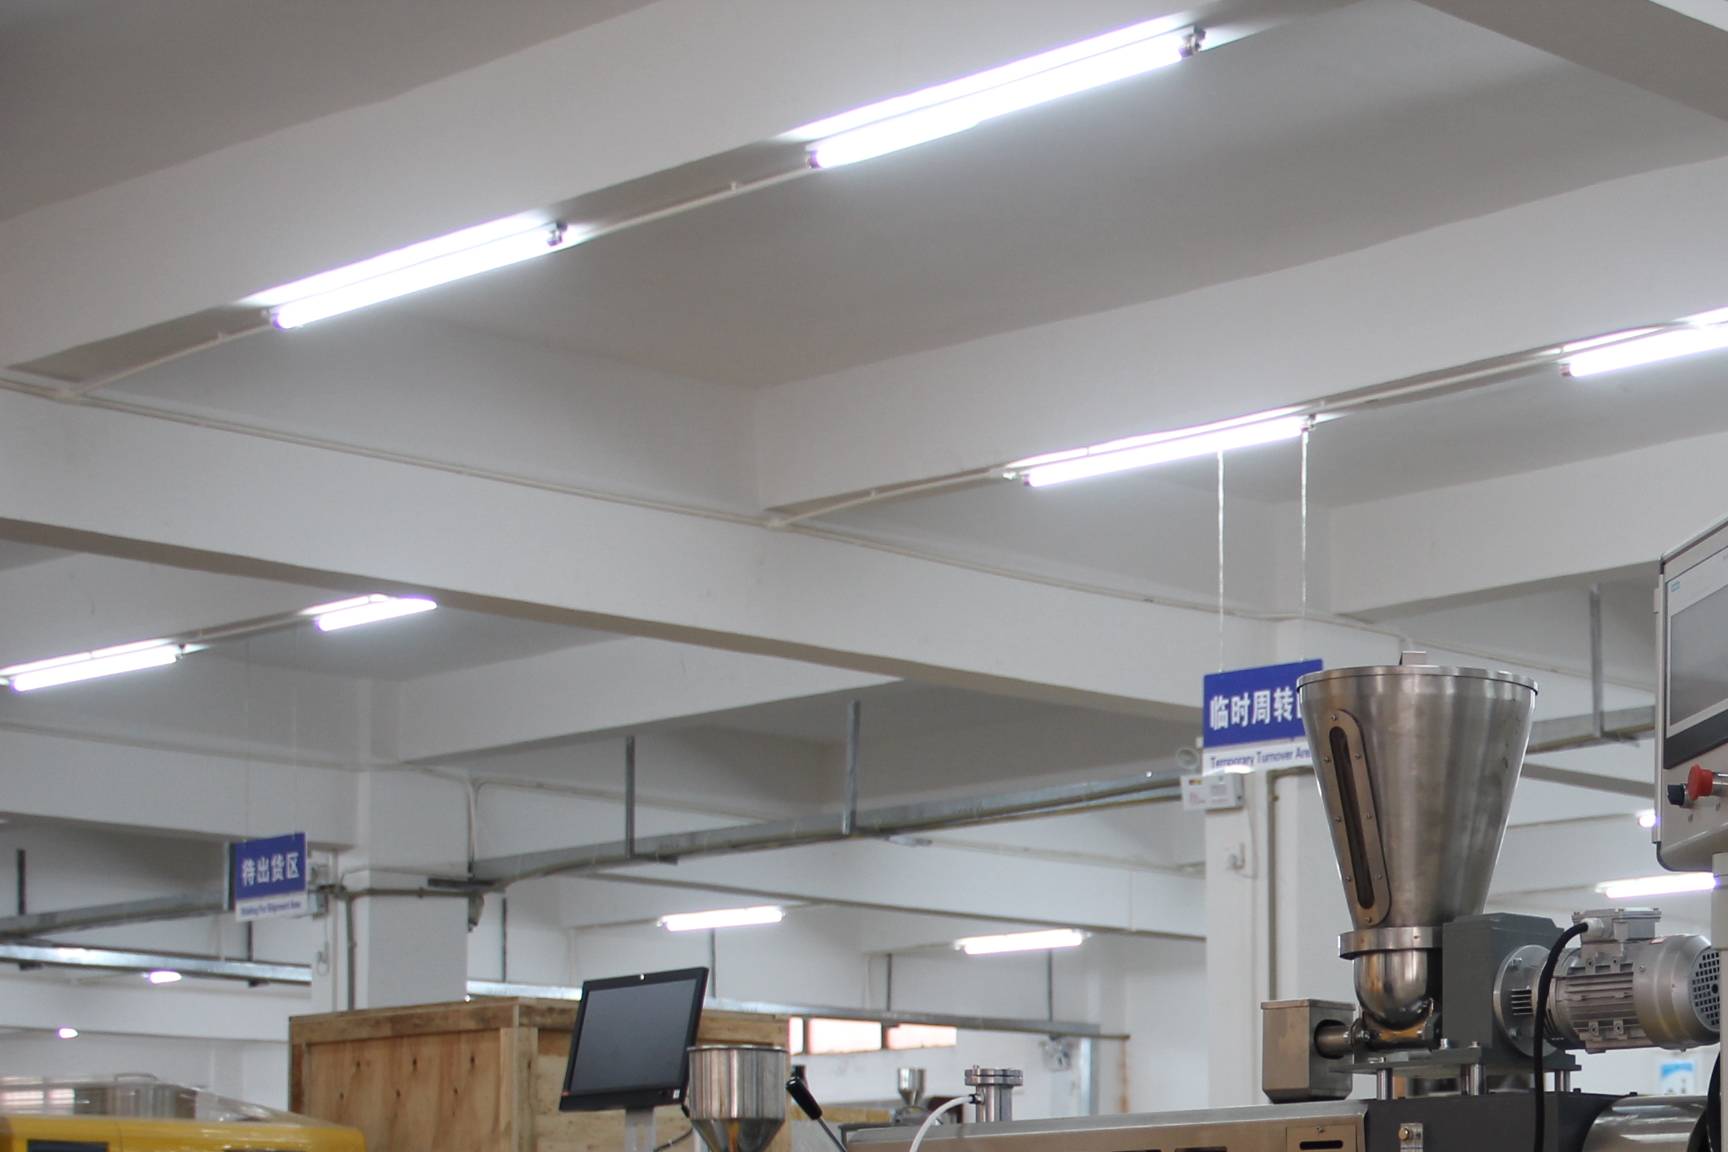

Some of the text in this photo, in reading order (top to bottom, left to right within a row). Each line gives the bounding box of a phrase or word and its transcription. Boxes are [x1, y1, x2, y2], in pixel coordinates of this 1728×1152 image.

[1209, 686, 1304, 731] 临时周转
[242, 852, 300, 887] 待出货区
